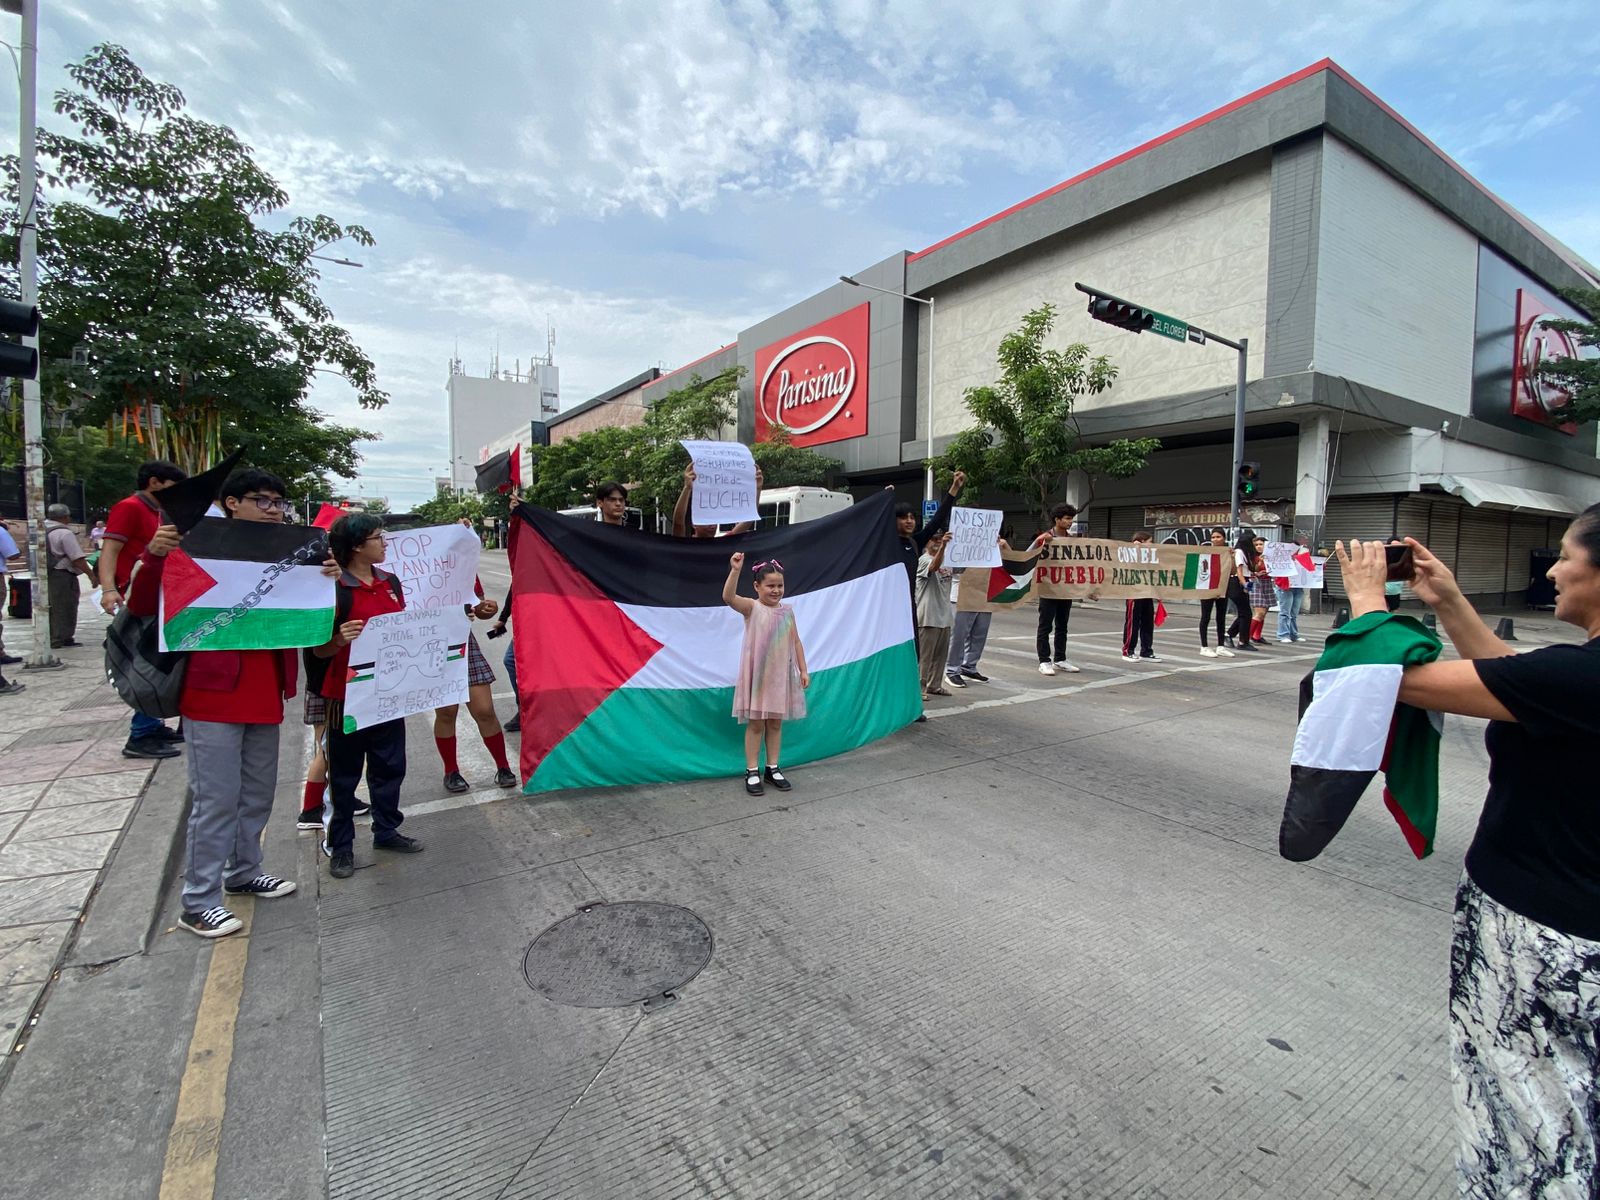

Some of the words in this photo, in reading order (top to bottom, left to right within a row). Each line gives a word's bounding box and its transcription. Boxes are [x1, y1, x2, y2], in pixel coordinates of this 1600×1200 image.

[1164, 322, 1185, 339] FLORES
[777, 363, 847, 412] Parisina
[699, 491, 750, 509] LUCHA
[954, 509, 970, 526] NO
[972, 512, 984, 528] ES
[1178, 513, 1232, 525] CATEDRA
[386, 534, 432, 560] TOP
[1039, 544, 1113, 561] SINALOA
[1117, 546, 1138, 563] CON
[1141, 547, 1160, 564] EL
[380, 553, 457, 577] TANYAHU
[1035, 566, 1105, 584] PUEBLO
[1112, 568, 1180, 586] PALESTINA
